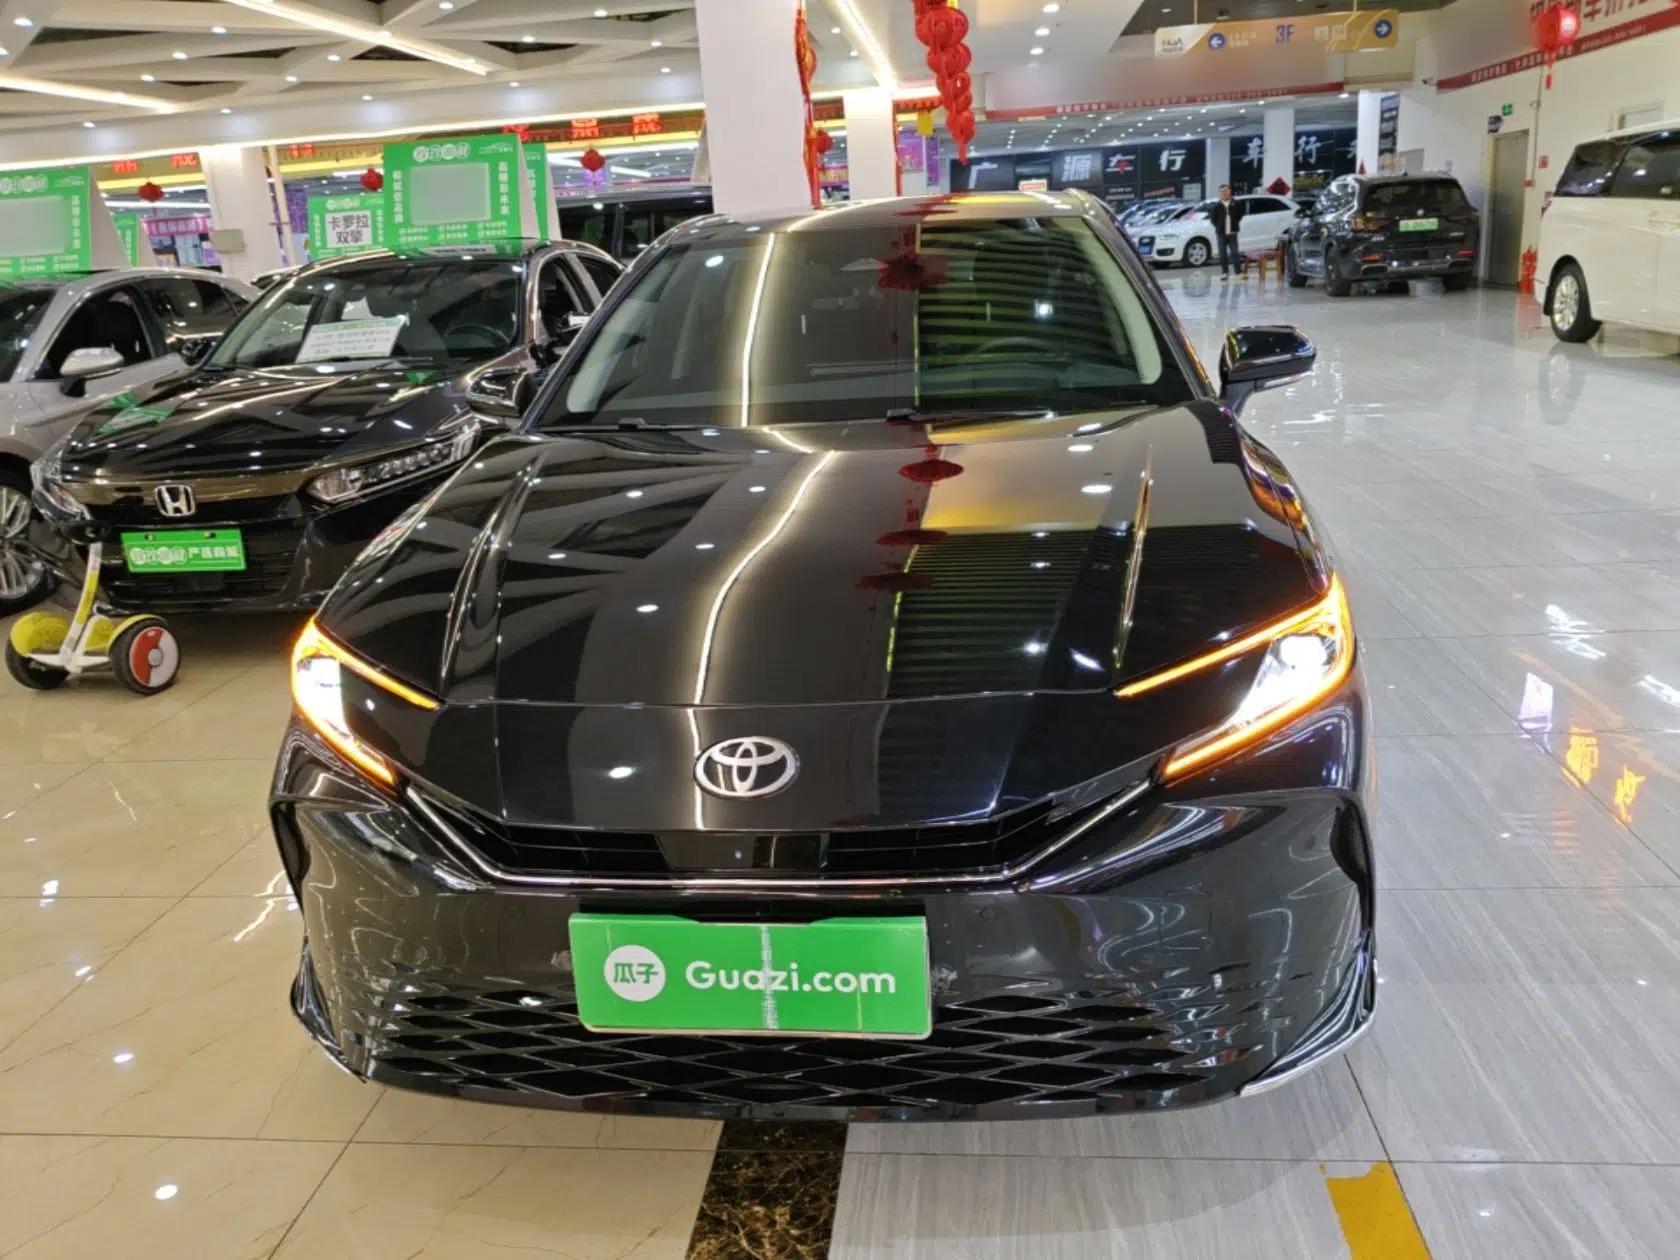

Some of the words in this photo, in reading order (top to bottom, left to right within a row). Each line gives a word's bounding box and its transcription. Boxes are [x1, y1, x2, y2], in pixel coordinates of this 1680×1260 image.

[328, 214, 369, 230] 卡罗拉
[612, 962, 659, 985] 瓜子
[685, 960, 896, 994] Guazi.com
